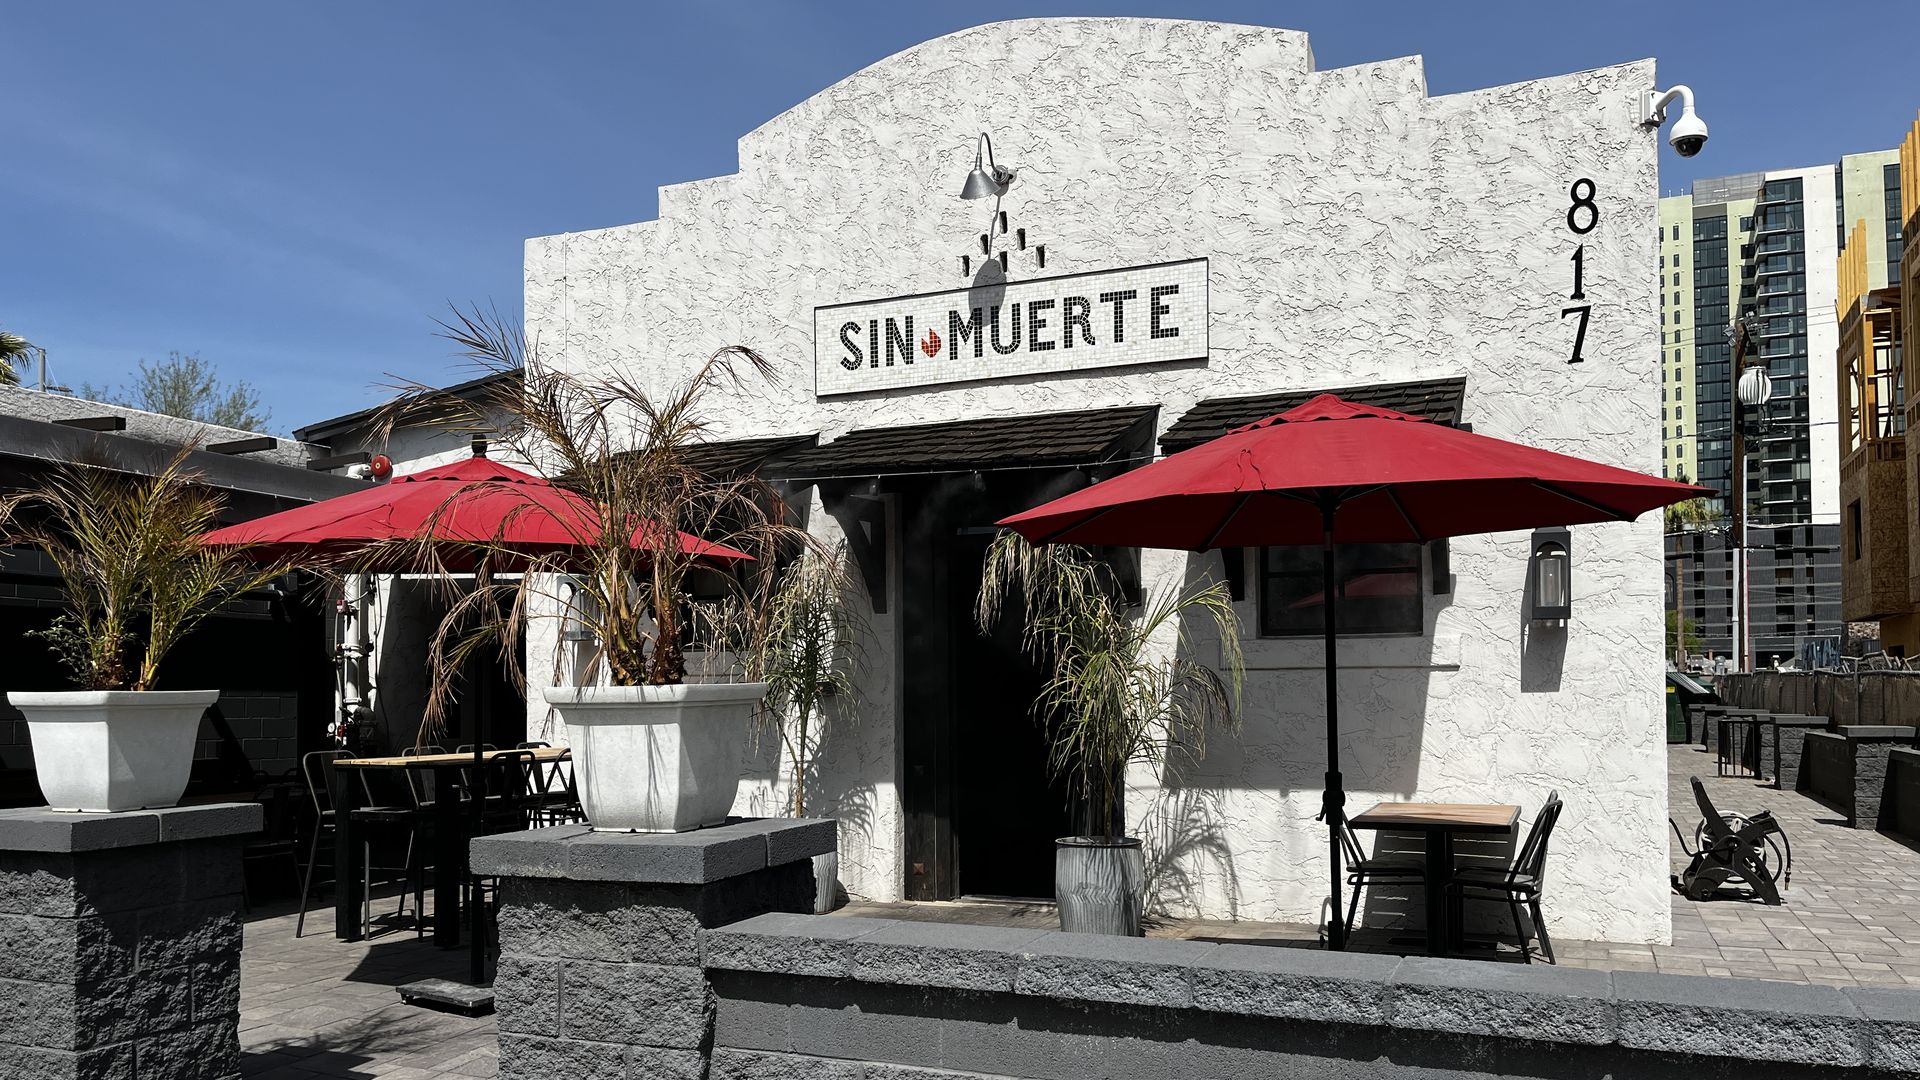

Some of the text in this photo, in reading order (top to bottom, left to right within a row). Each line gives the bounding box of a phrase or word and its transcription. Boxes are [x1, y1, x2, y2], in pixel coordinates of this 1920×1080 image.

[839, 284, 1180, 371] SIN MUERTE
[1562, 178, 1599, 364] 817
